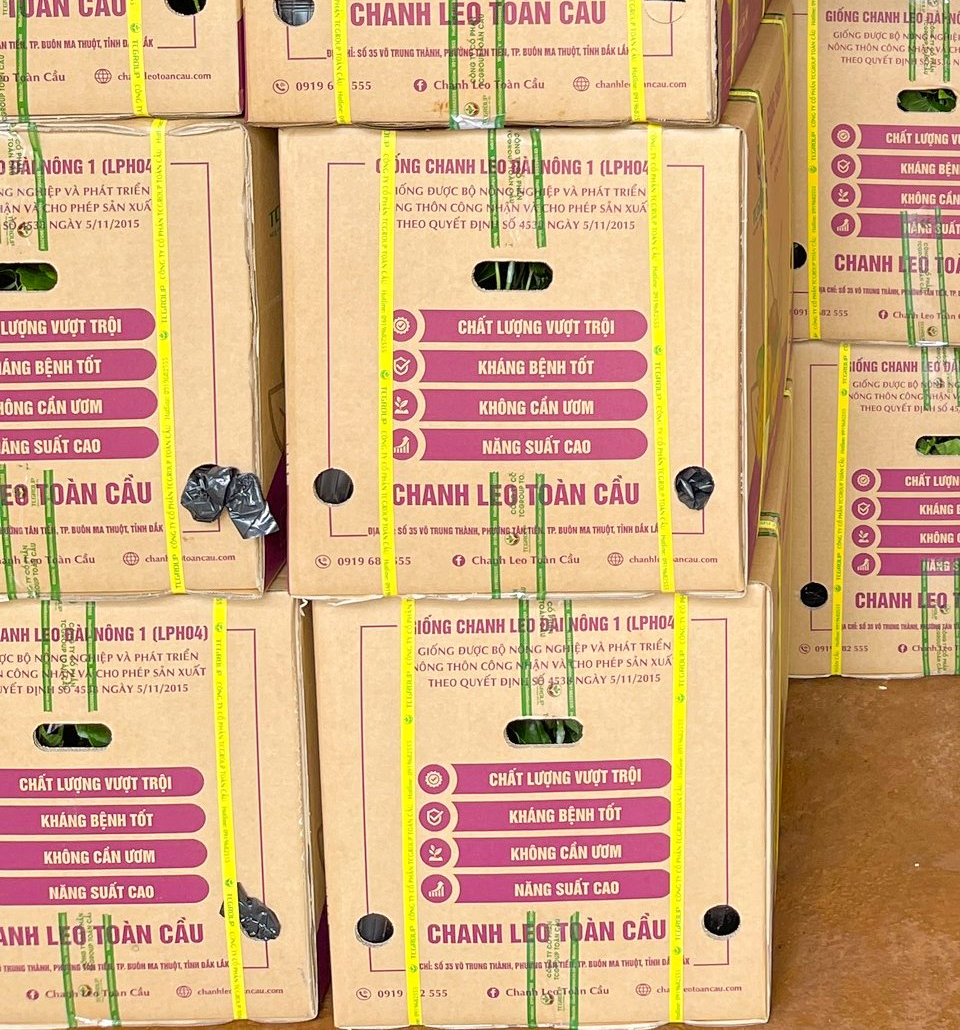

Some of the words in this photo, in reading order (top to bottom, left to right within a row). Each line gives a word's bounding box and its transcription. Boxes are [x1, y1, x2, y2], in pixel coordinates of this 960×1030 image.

[350, 2, 431, 26] CHANH
[296, 82, 324, 91] 0919
[351, 81, 372, 90] 555
[901, 161, 936, 174] KHÁNG
[901, 191, 936, 205] KHÔNG
[939, 190, 960, 205] CẦN
[1, 319, 47, 338] LƯỢNG
[51, 318, 86, 337] VƯỢT
[90, 316, 122, 336] TRỘI
[458, 315, 493, 334] CHẤT
[497, 319, 542, 337] LƯỢNG
[546, 319, 581, 337] VƯỢT
[584, 317, 614, 337] TRỘI
[482, 437, 521, 454] NĂNG
[525, 435, 560, 454] SUẤT
[564, 440, 591, 454] CAO
[395, 483, 469, 506] CHANH
[594, 474, 639, 505] CẦU
[919, 502, 954, 515] KHÁNG
[153, 626, 208, 641] (LPH04)
[489, 768, 523, 786] CHẤT
[527, 770, 571, 788] LƯỢNG
[575, 769, 608, 787] VƯỢT
[611, 766, 641, 785] TRỘI
[41, 812, 86, 828] KHÁNG
[90, 811, 126, 830] BỆNH
[129, 809, 153, 827] TỐT
[511, 844, 556, 861] KHÔNG
[560, 841, 588, 860] CẦN
[591, 844, 622, 859] ƯƠM
[49, 884, 87, 899] NĂNG
[90, 882, 124, 899] SUẤT
[128, 885, 154, 899] CAO
[427, 924, 502, 944] CHANH
[623, 912, 666, 941] CẦU
